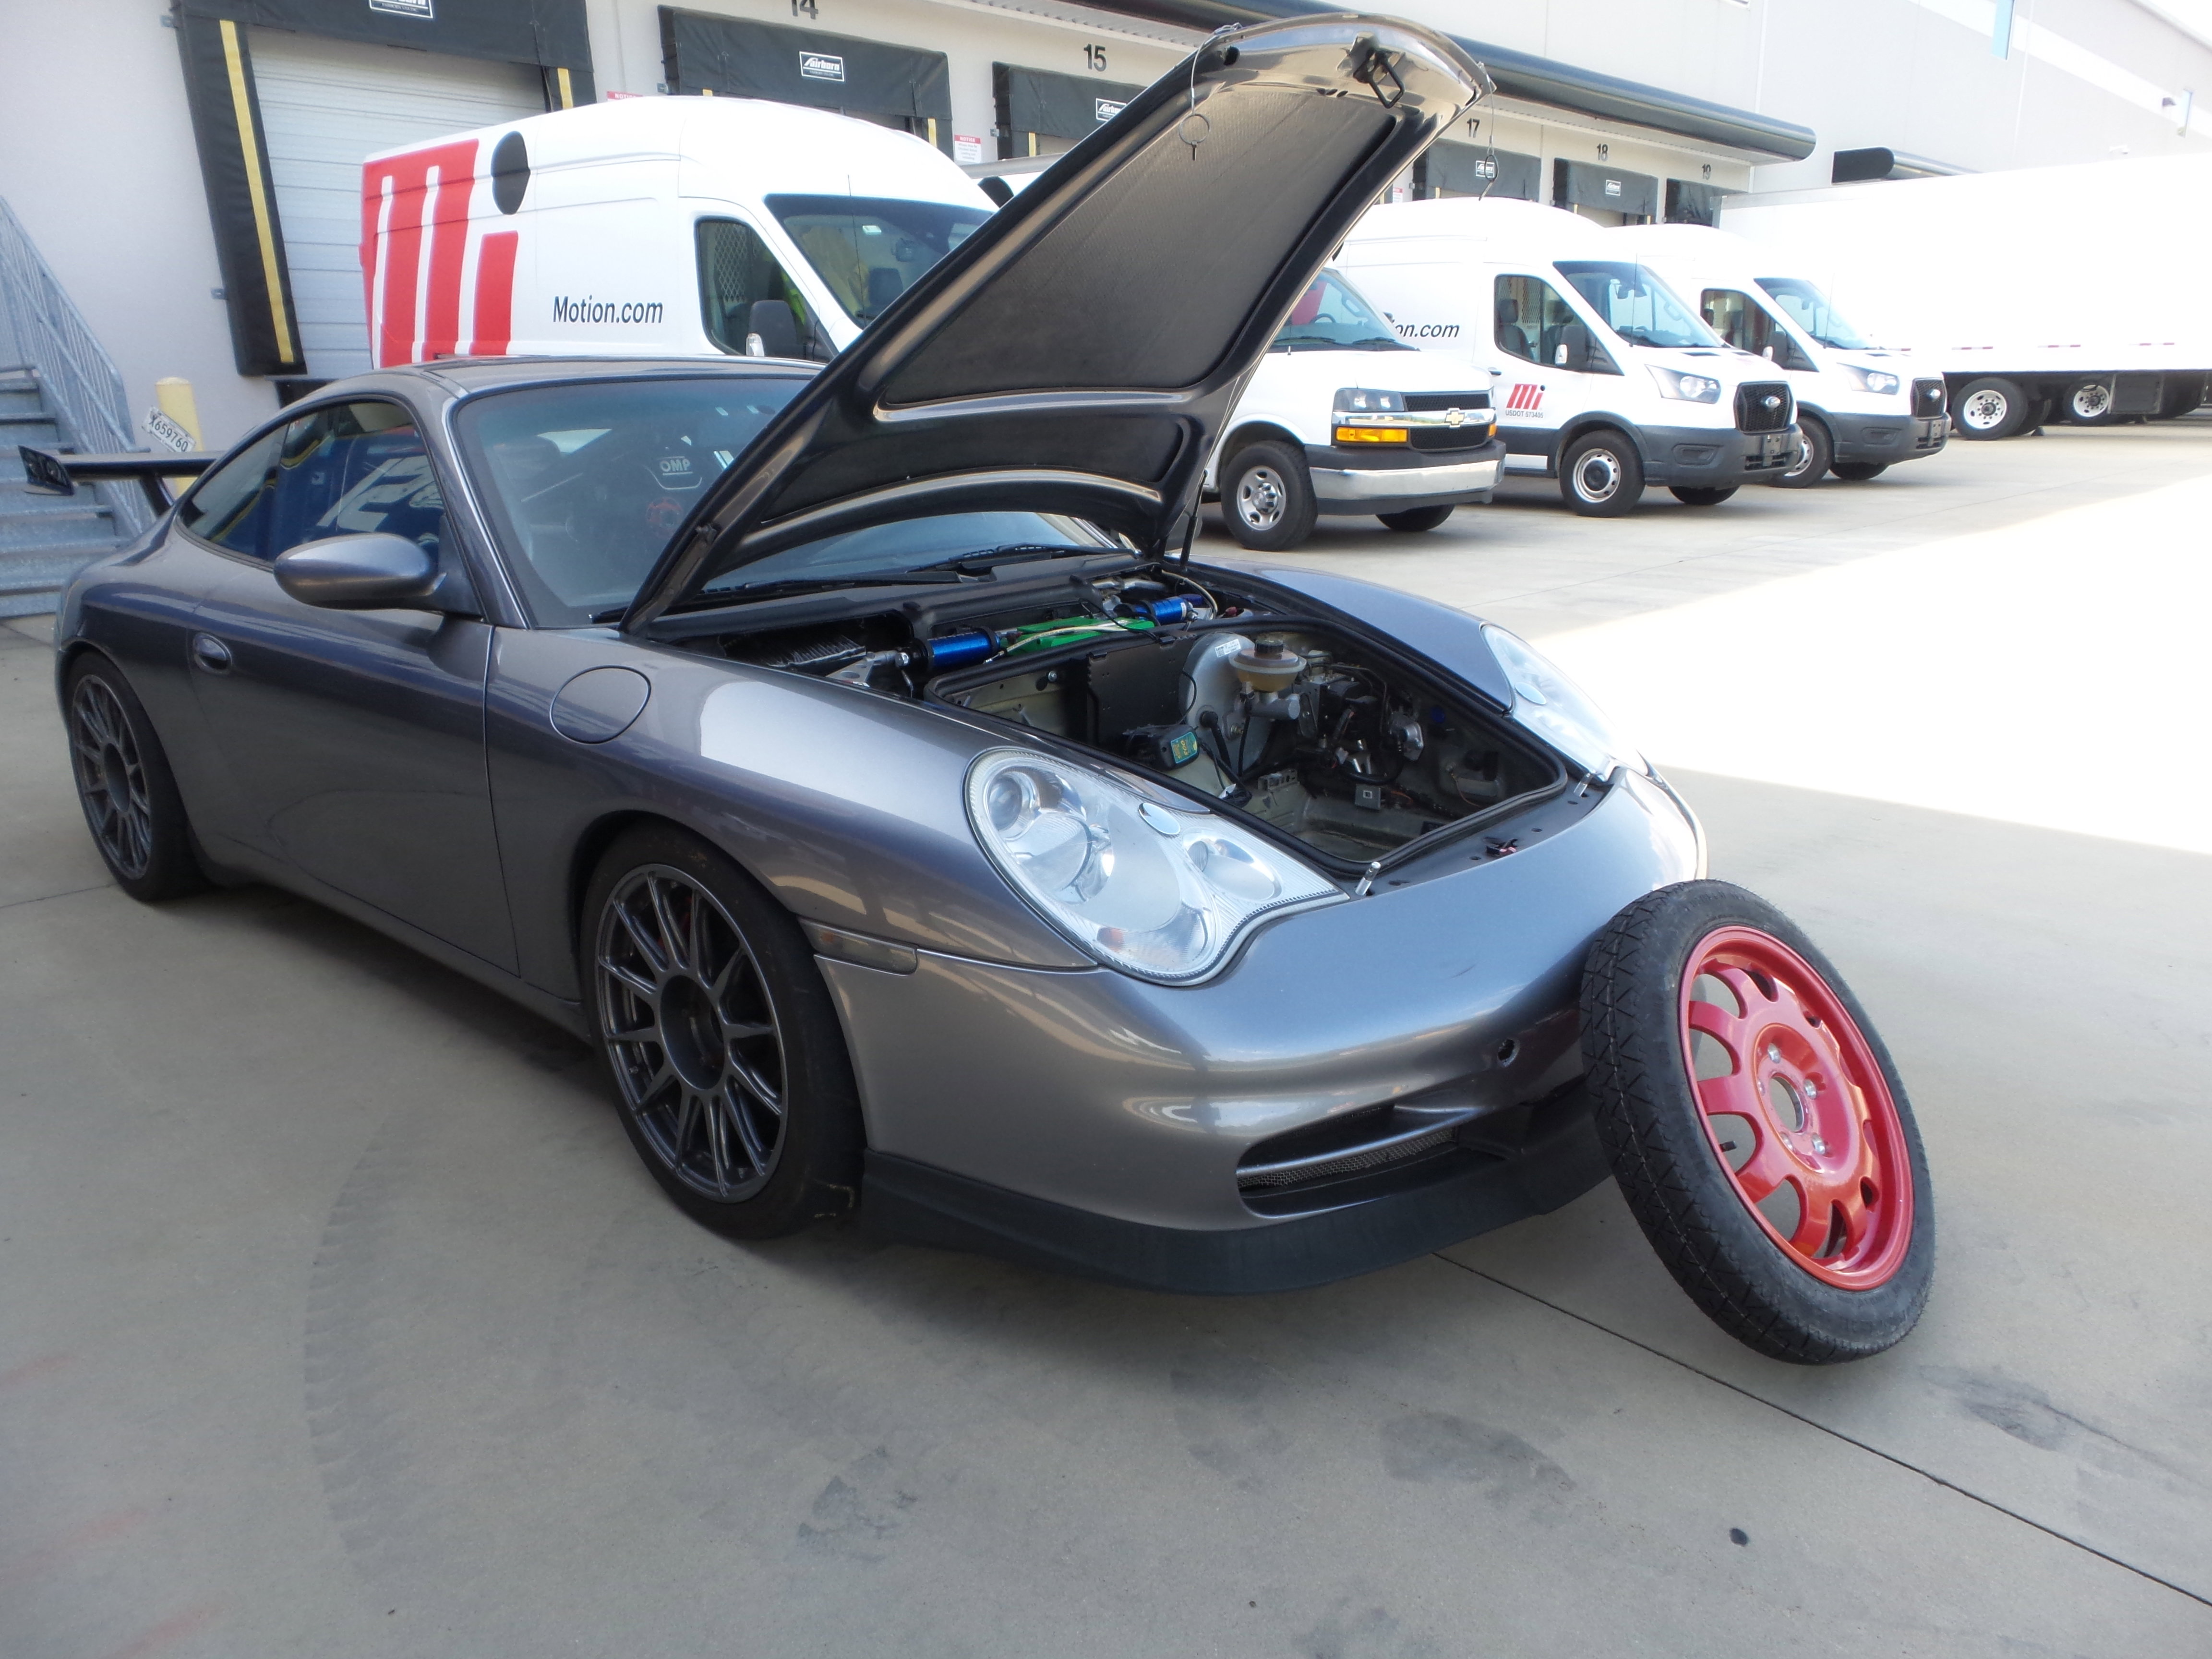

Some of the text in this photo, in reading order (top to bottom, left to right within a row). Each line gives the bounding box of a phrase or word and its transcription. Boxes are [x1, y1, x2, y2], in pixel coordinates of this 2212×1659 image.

[792, 0, 818, 20] 14
[804, 57, 840, 71] Fairborn
[1083, 44, 1107, 72] 15
[1467, 118, 1480, 138] 17
[1597, 144, 1608, 161] 18
[553, 295, 663, 323] Motion.com
[149, 414, 188, 452] X659760
[660, 459, 690, 472] OMP
